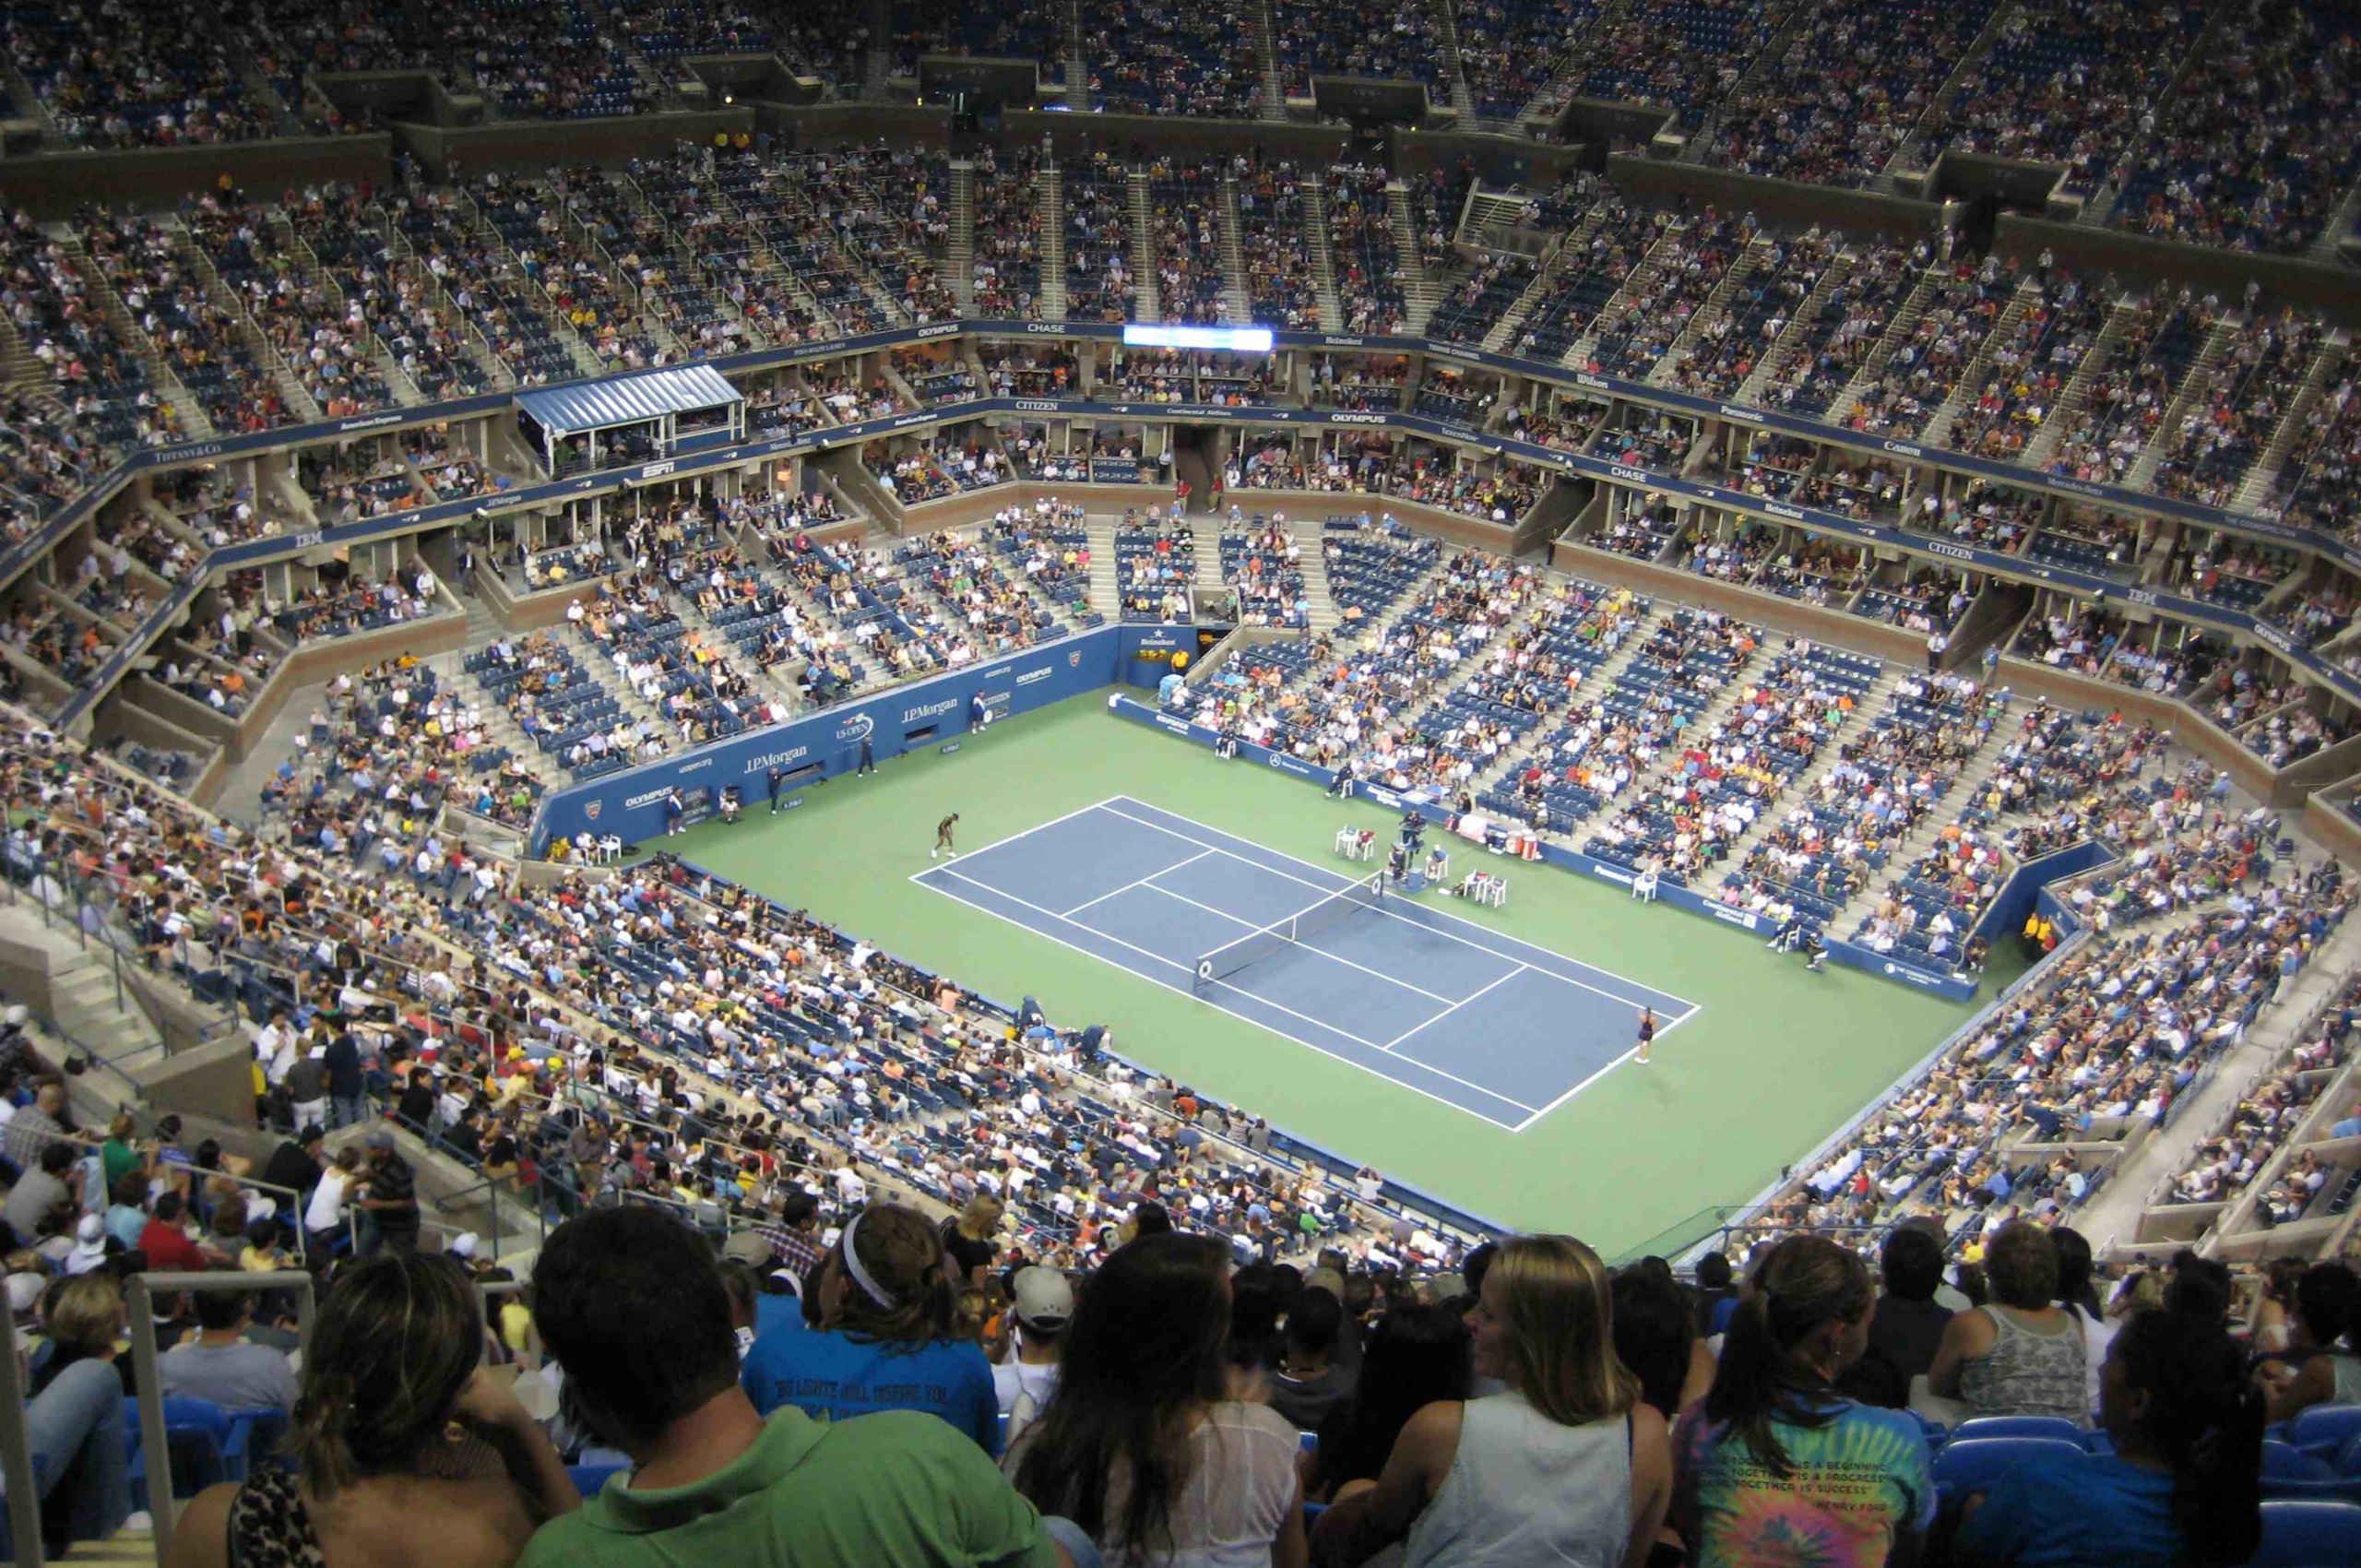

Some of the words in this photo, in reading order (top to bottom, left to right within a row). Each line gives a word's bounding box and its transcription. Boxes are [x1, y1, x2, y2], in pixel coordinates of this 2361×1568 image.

[918, 325, 958, 338] OLYMPUS
[1027, 324, 1066, 333] CHASE
[1577, 374, 1608, 389] Wilson
[1015, 400, 1059, 411] CITIZEN
[1331, 413, 1386, 424] OLYMPUS
[1884, 440, 1921, 457] Canon
[642, 461, 675, 479] ESPN
[1611, 467, 1647, 482] CHASE
[295, 532, 324, 548] IBM
[1928, 541, 1975, 560] CITIZEN
[2127, 588, 2156, 606] IBM
[2254, 624, 2291, 652] OLYMPUS
[1015, 666, 1052, 683] OLYMPUS
[836, 729, 847, 739] US
[847, 724, 868, 736] OPEN
[625, 785, 673, 807] OLYMPUS
[1800, 1483, 1811, 1492] IS
